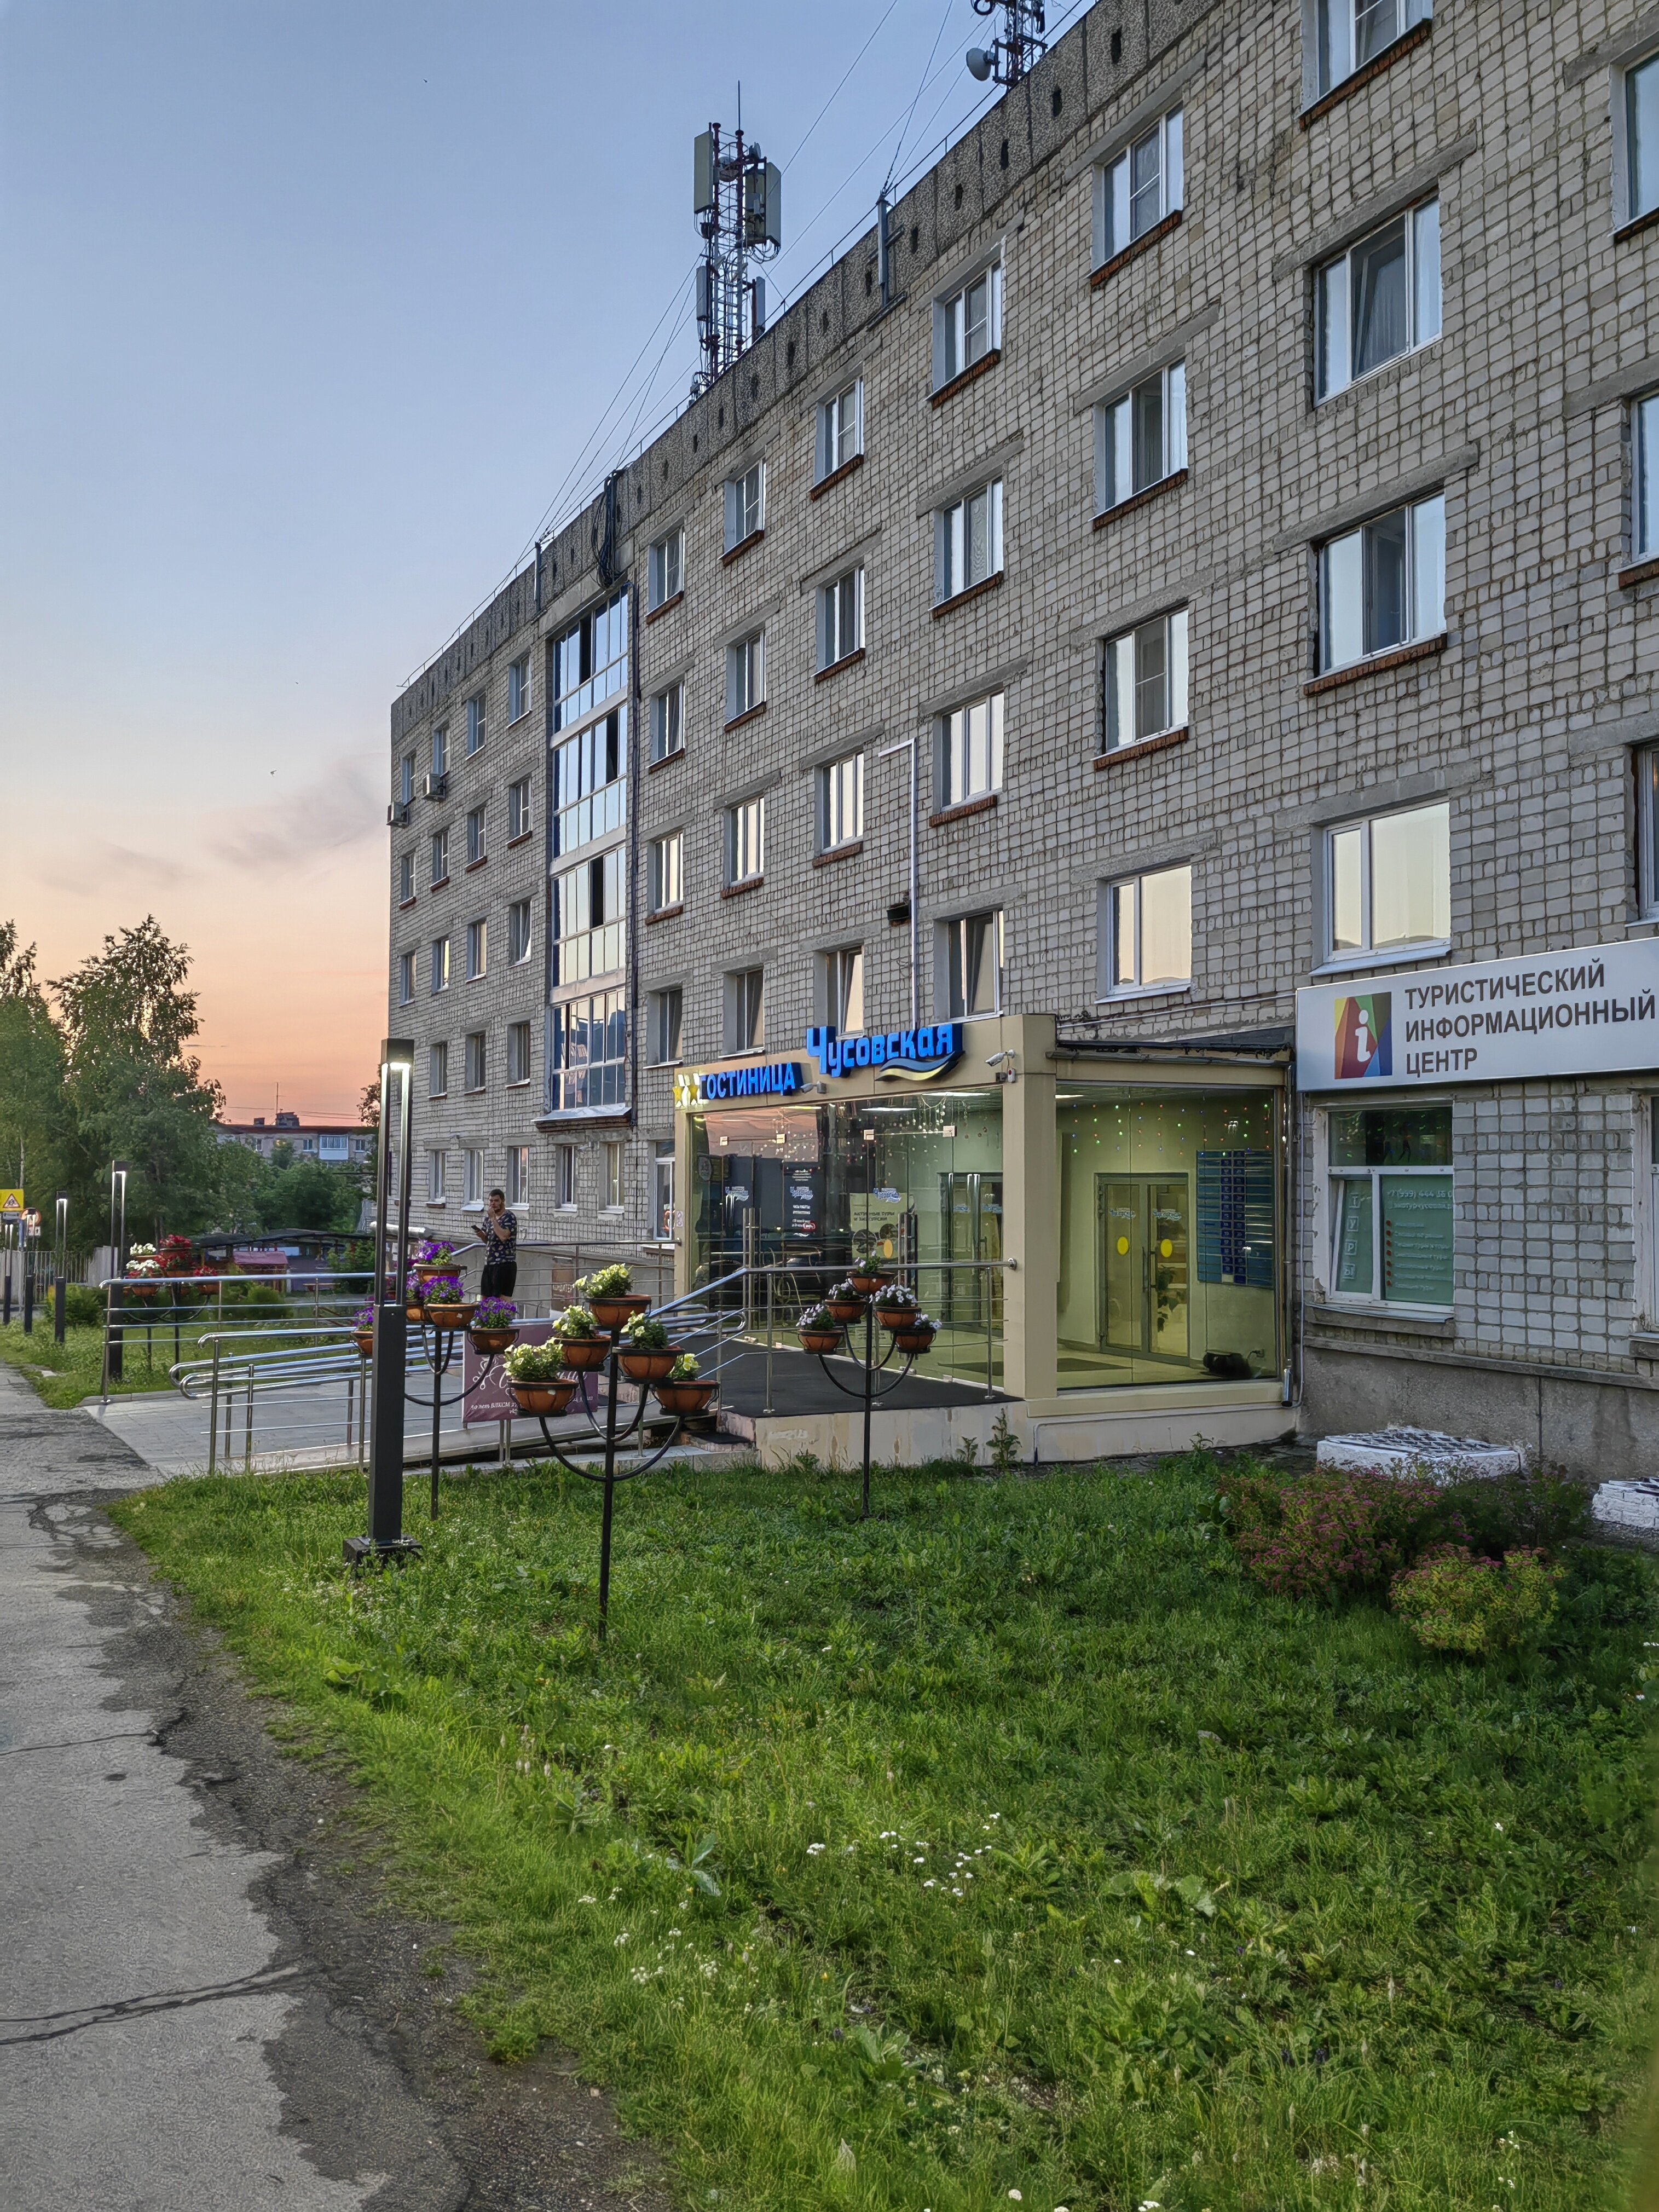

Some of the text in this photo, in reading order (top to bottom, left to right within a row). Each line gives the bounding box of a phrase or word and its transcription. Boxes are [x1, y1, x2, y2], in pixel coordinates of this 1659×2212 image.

[1405, 958, 1604, 1009] ТУРИСТИЧЕСКИЙ
[1406, 989, 1655, 1042] ИНФОРМАЦИОННЫЙ
[807, 1024, 955, 1077] Чусовская
[1407, 1048, 1477, 1078] ЦЕНТР
[700, 1061, 796, 1100] ГОСТИНИЦА
